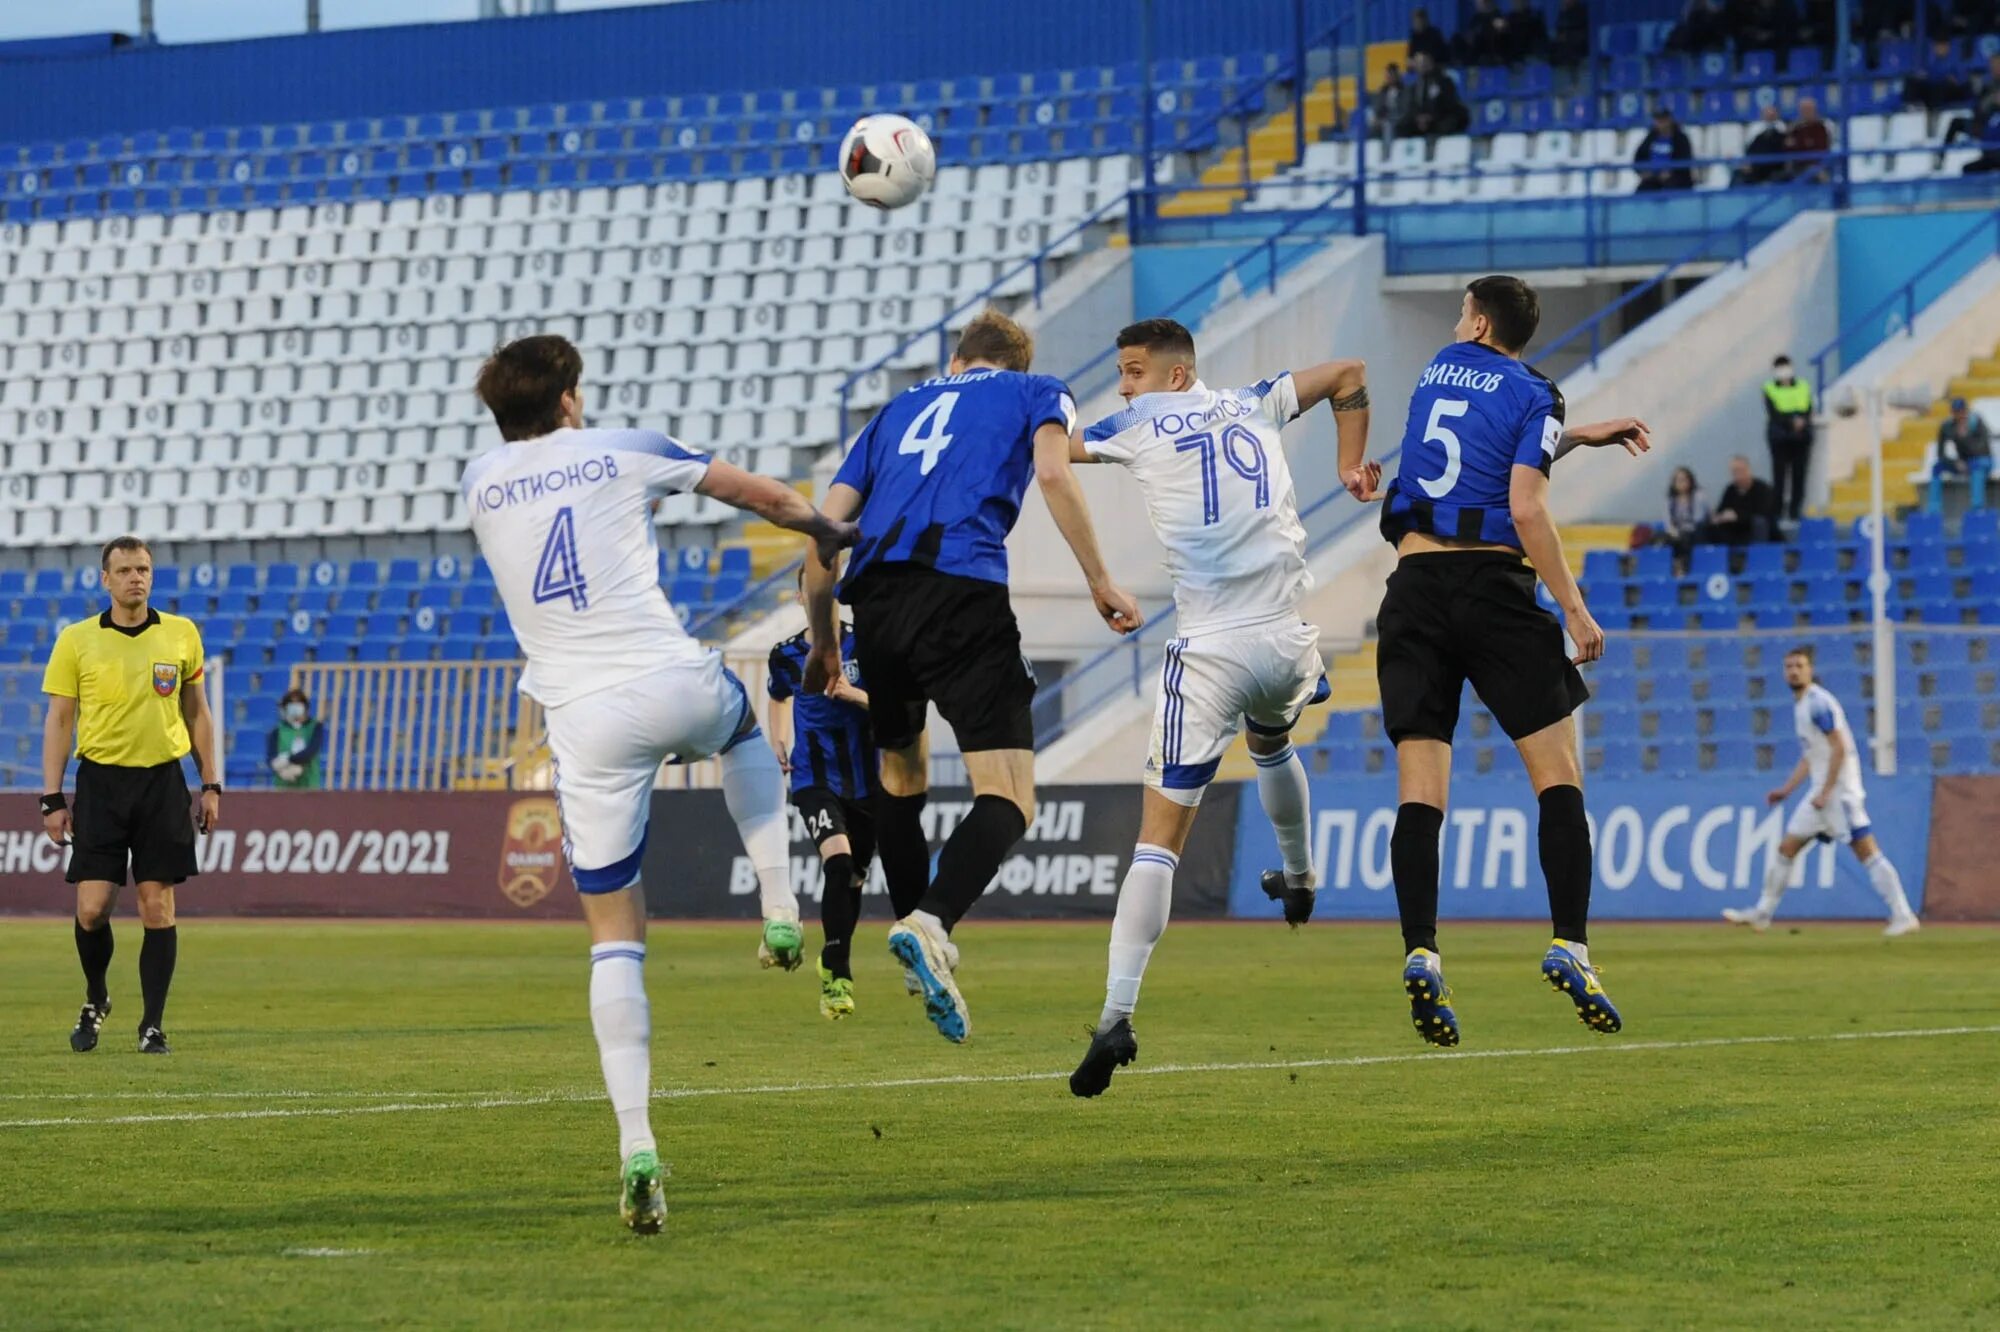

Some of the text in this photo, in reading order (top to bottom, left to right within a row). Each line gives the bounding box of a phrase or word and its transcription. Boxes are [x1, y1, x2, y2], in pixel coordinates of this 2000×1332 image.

[1419, 363, 1504, 393] ЗИНКОВ
[898, 391, 961, 476] 4
[1417, 398, 1469, 499] 5
[476, 455, 619, 514] ЛОКТИОНОВ
[1174, 423, 1270, 527] 79
[532, 506, 588, 611] 4
[242, 829, 450, 874] 2020/2021
[808, 808, 834, 840] 24
[1313, 808, 1527, 890] ПОТА
